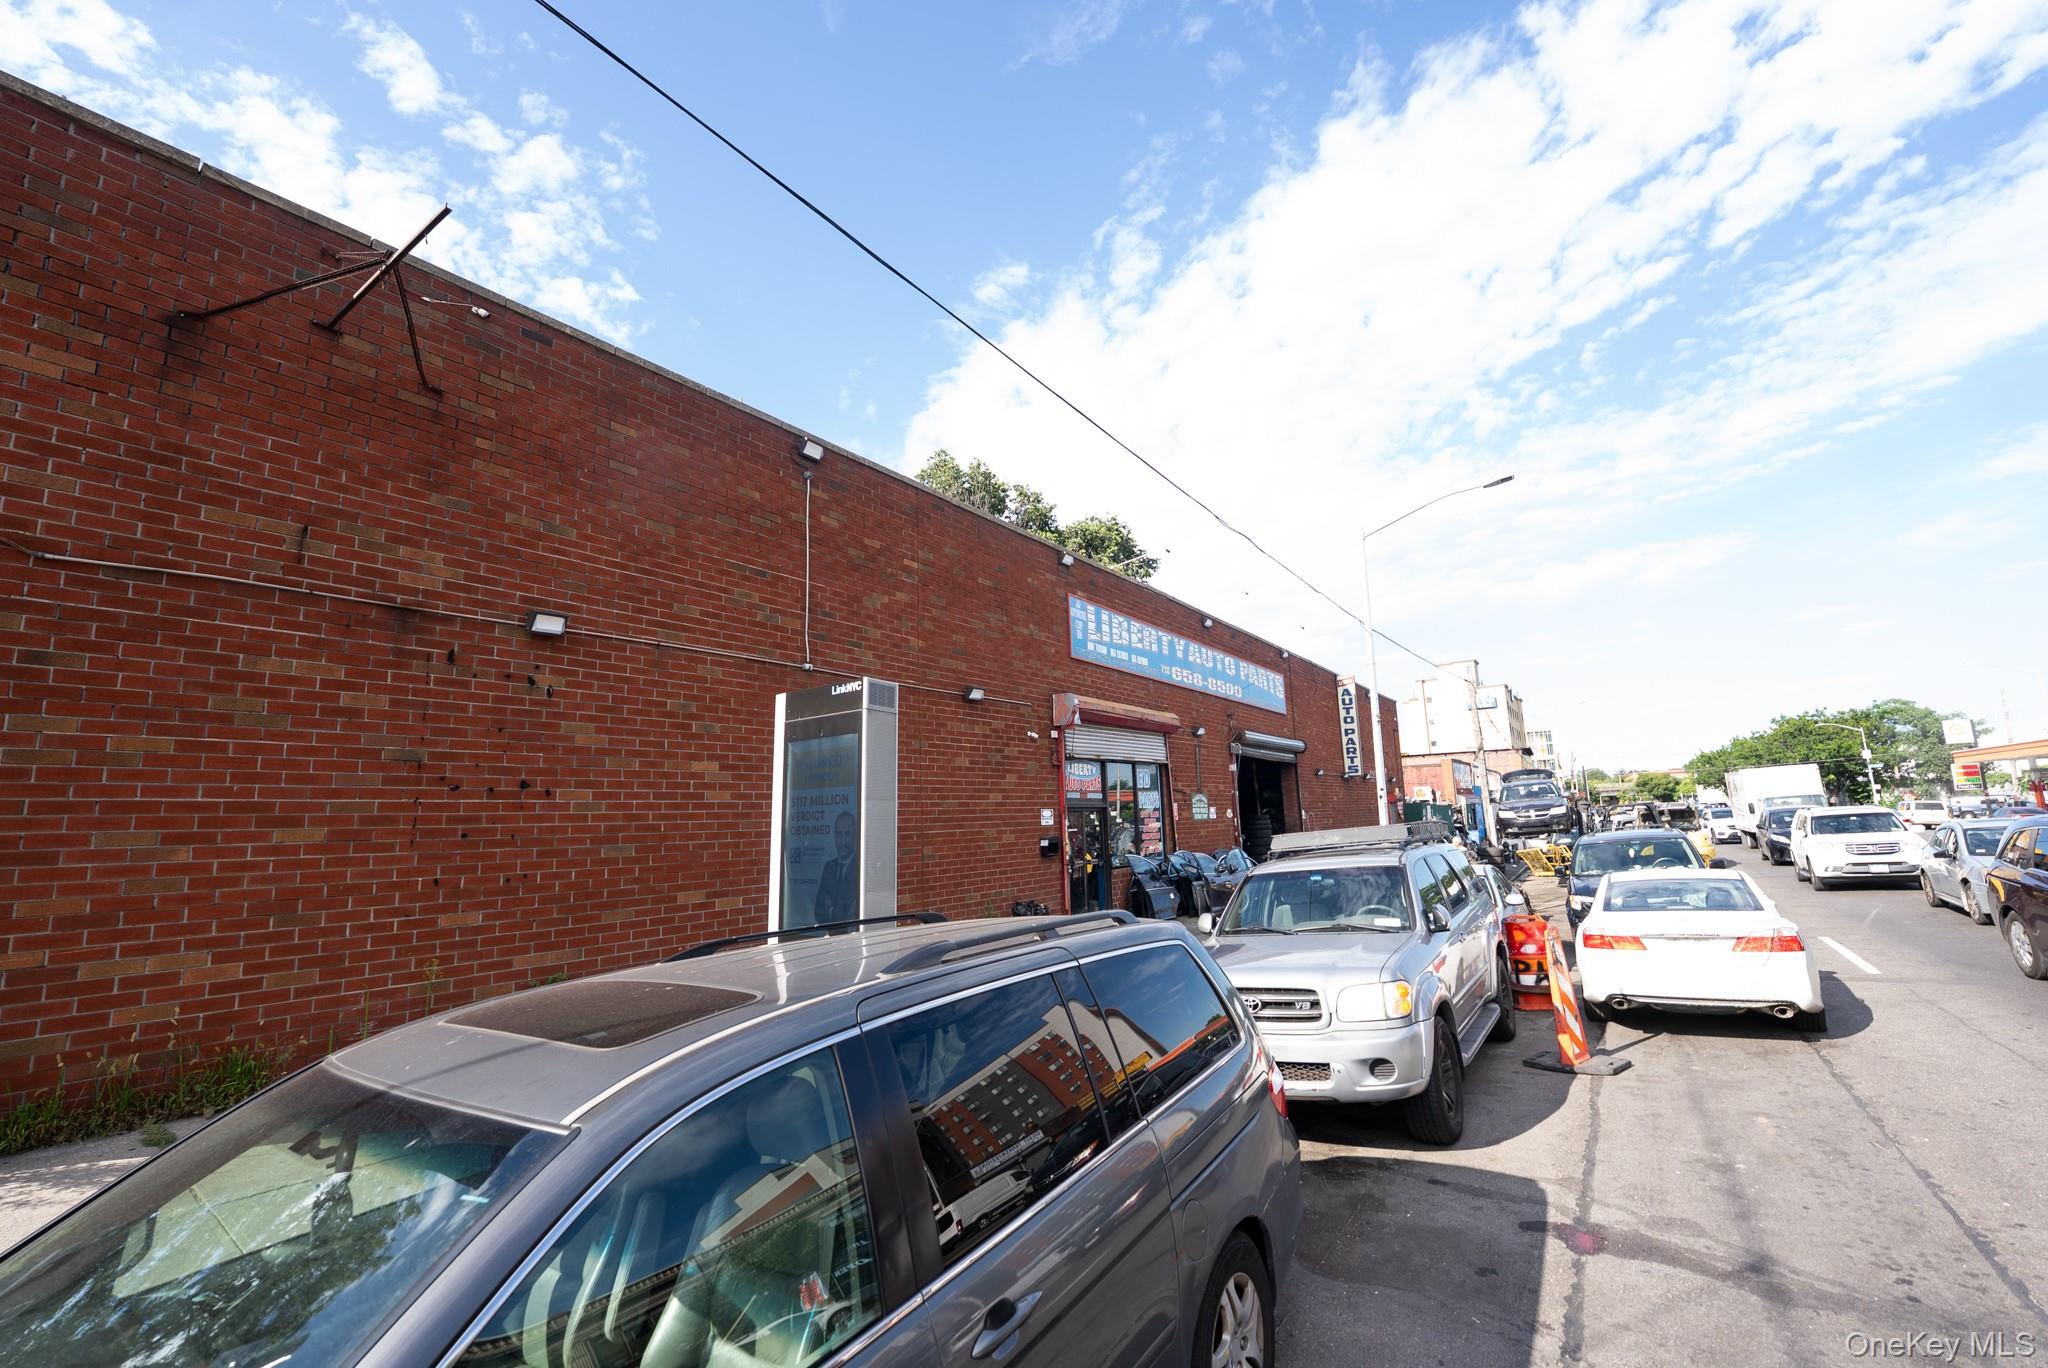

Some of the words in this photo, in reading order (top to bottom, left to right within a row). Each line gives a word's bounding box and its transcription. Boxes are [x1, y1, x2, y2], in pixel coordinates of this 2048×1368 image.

[1086, 604, 1186, 659] LIBERTY
[1188, 641, 1236, 676] AUTO
[1239, 661, 1284, 698] PARTS
[831, 680, 863, 695] LinkNYC
[1341, 688, 1356, 724] AUTO
[1344, 728, 1360, 775] PARTS
[1067, 762, 1097, 776] LIBERTY
[810, 793, 849, 807] MILLION
[791, 824, 832, 836] OBTAINED
